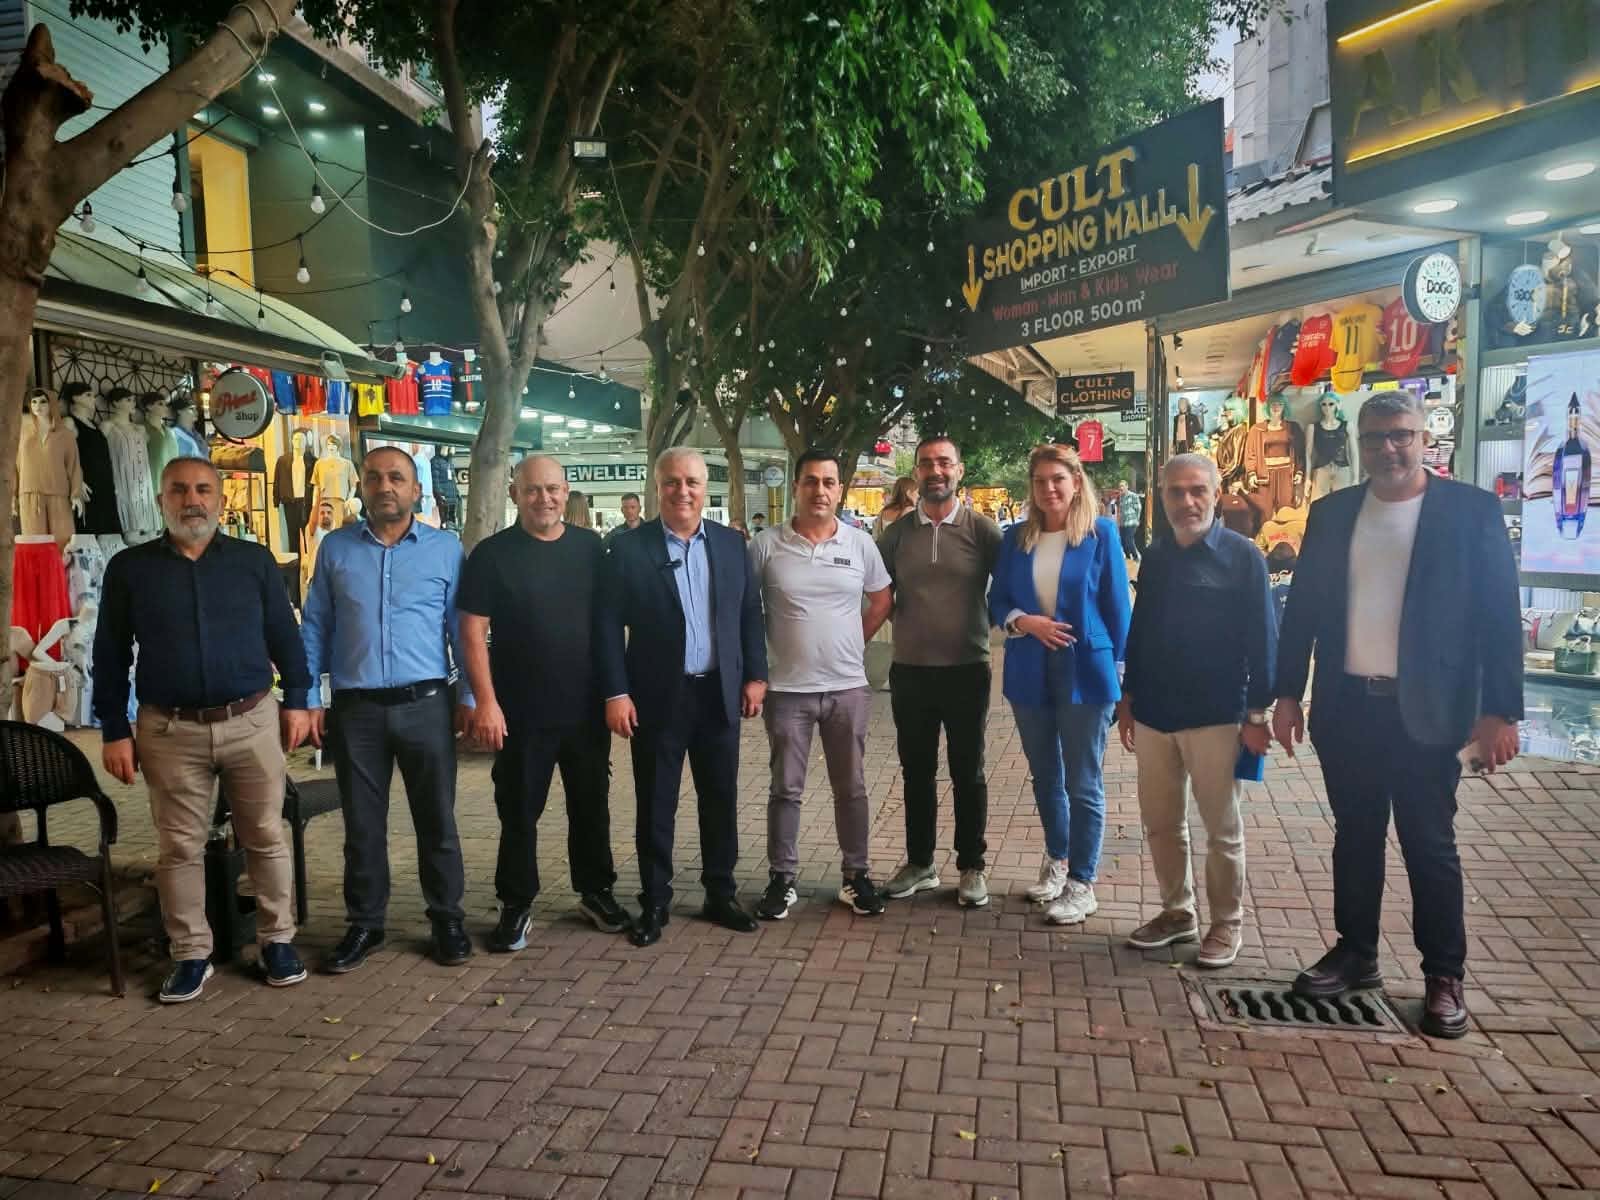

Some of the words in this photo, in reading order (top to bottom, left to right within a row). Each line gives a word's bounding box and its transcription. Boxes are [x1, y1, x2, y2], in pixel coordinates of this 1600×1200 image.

[1008, 146, 1136, 231] CULT
[983, 215, 1098, 280] SHOPPING
[1104, 188, 1176, 245] MALL
[1020, 264, 1067, 290] IMPORT
[1079, 245, 1137, 274] EXPORT
[1021, 321, 1029, 337] 3
[1034, 309, 1085, 335] FLOOR
[1091, 299, 1124, 322] 500
[1345, 325, 1359, 355] 11
[1390, 319, 1417, 353] 10
[1060, 387, 1132, 404] CLOTHING
[1074, 376, 1116, 389] CULT
[1087, 434, 1095, 450] 7
